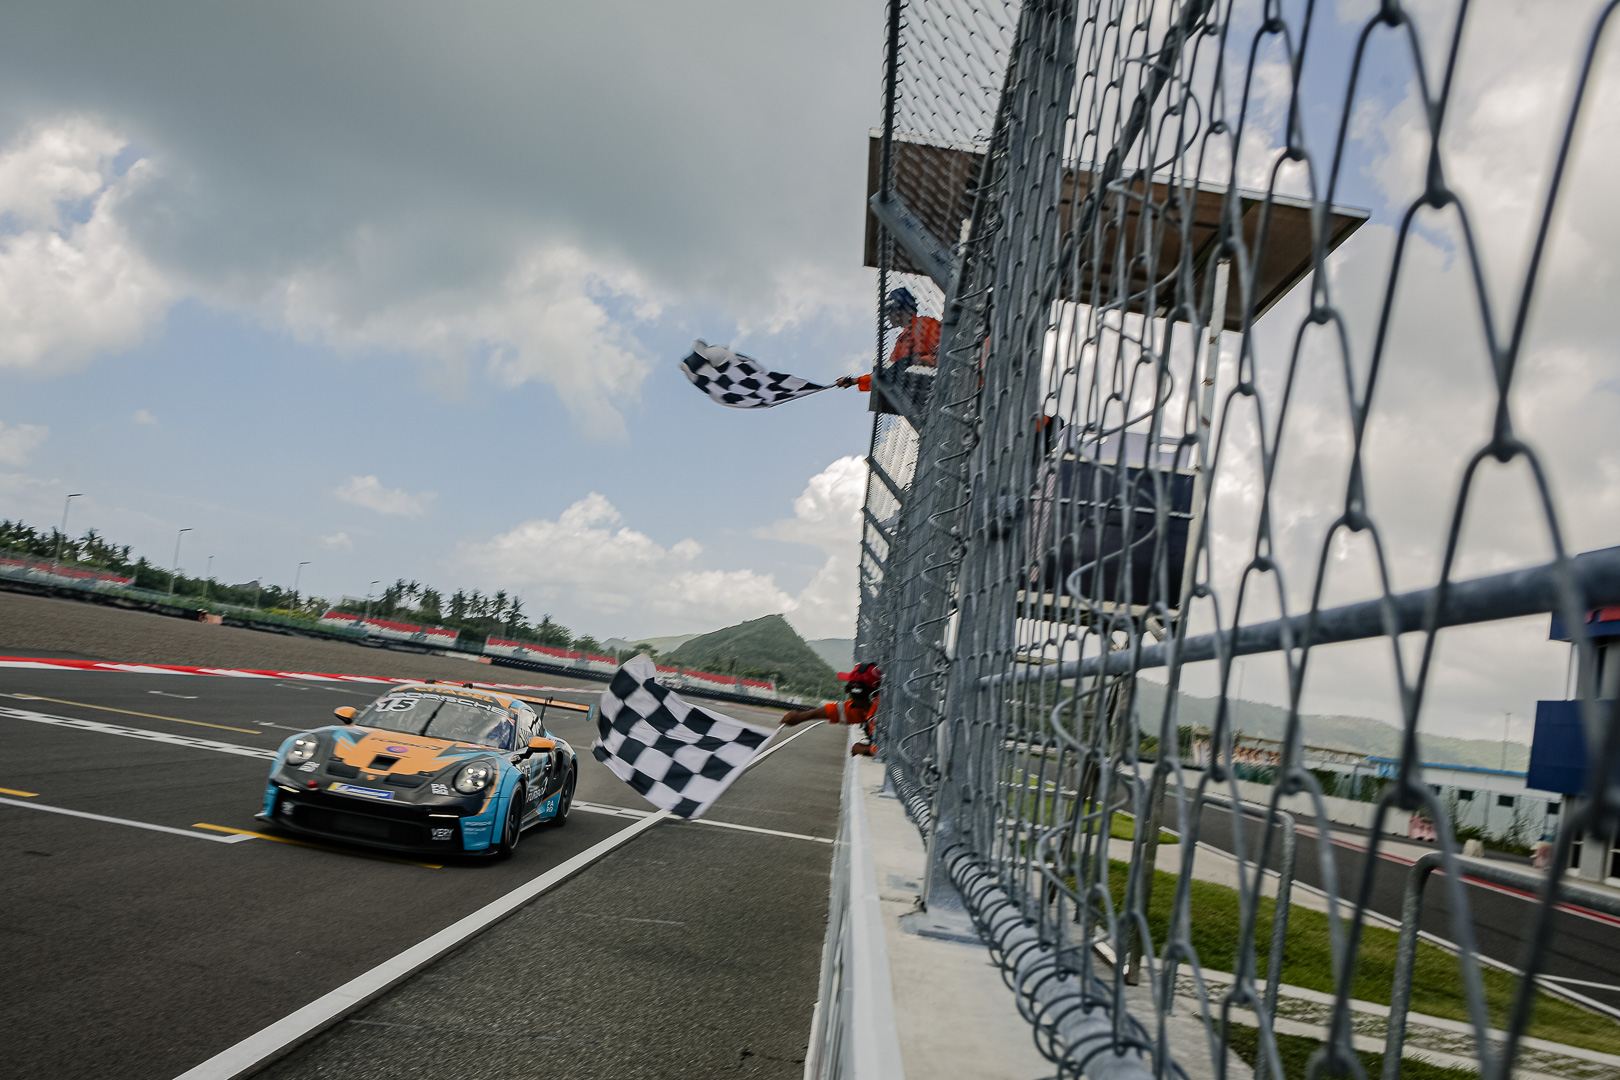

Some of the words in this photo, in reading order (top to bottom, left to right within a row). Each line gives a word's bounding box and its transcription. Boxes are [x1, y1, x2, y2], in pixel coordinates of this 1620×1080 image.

[413, 687, 494, 703] CITADEL
[375, 697, 420, 712] 15
[388, 692, 509, 717] PORSCHE
[431, 828, 454, 837] VERY
